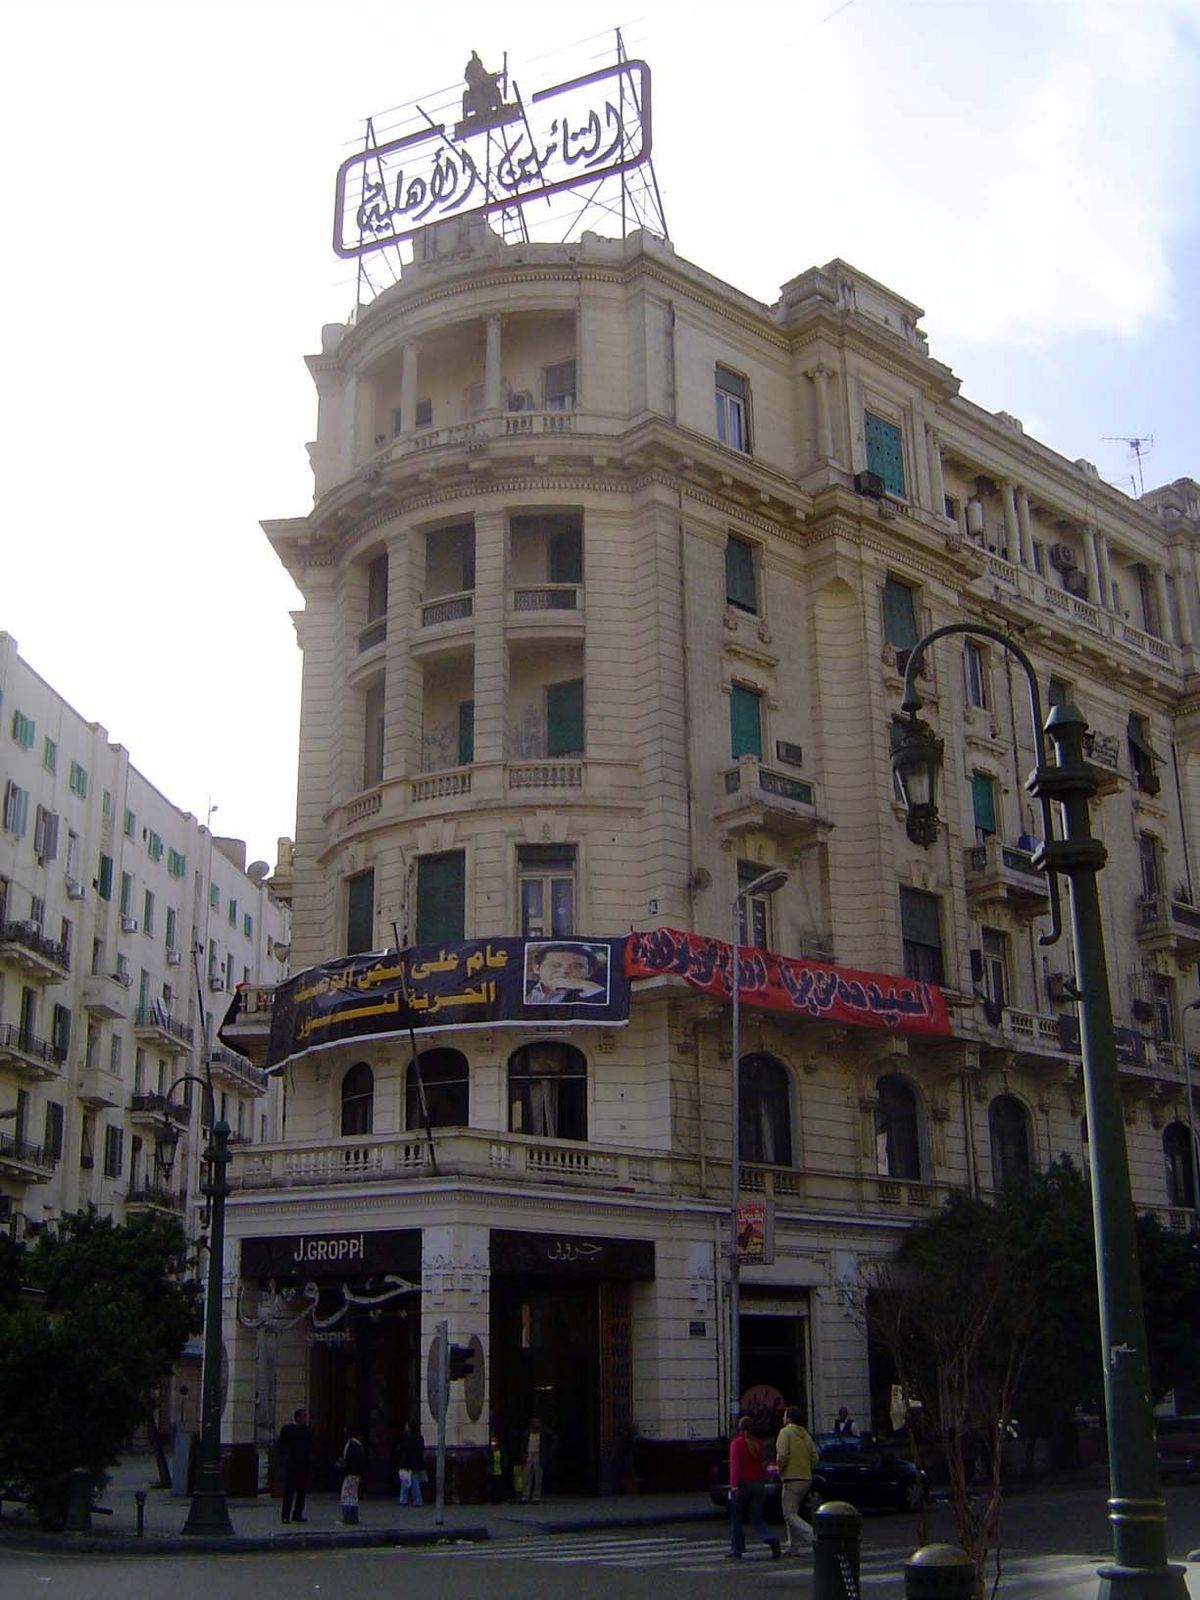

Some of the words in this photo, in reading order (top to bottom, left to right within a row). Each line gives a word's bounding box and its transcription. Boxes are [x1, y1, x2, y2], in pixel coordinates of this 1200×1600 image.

[411, 949, 459, 980] على
[465, 944, 509, 978] عام
[408, 981, 496, 1014] الحرية
